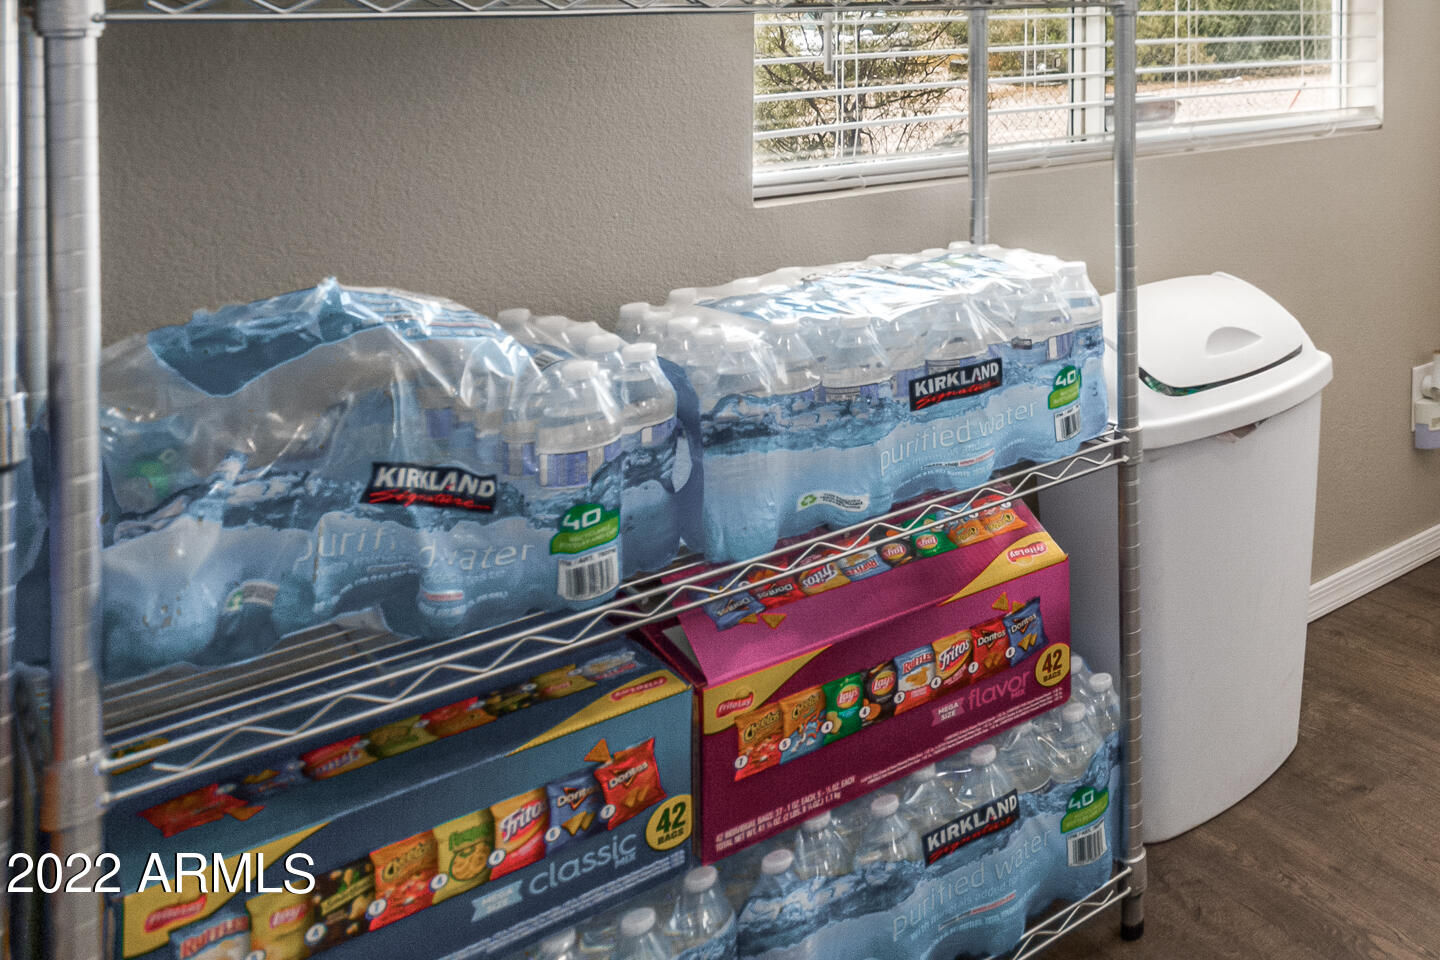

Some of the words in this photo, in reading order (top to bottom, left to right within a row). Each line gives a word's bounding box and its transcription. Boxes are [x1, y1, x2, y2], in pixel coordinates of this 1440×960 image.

[914, 362, 999, 397] KIRKLAND
[1055, 369, 1076, 386] 40
[880, 419, 971, 477] purified
[979, 401, 1038, 437] water
[374, 466, 495, 498] KIRKLAND
[562, 507, 601, 530] 40
[802, 563, 839, 588] Fritos
[1010, 613, 1037, 633] Doritos
[977, 631, 1006, 647] Doritos
[938, 639, 971, 672] Fritos
[1041, 649, 1063, 673] 42
[967, 671, 1030, 711] flavor
[1043, 670, 1062, 683] BAGS
[608, 761, 648, 790] Doritos
[1068, 791, 1095, 809] 40
[656, 801, 686, 834] 42
[927, 795, 1018, 851] KIRKLAND
[657, 827, 685, 846] BAGS
[529, 833, 637, 895] classic
[892, 866, 986, 942] purified
[993, 831, 1050, 880] water
